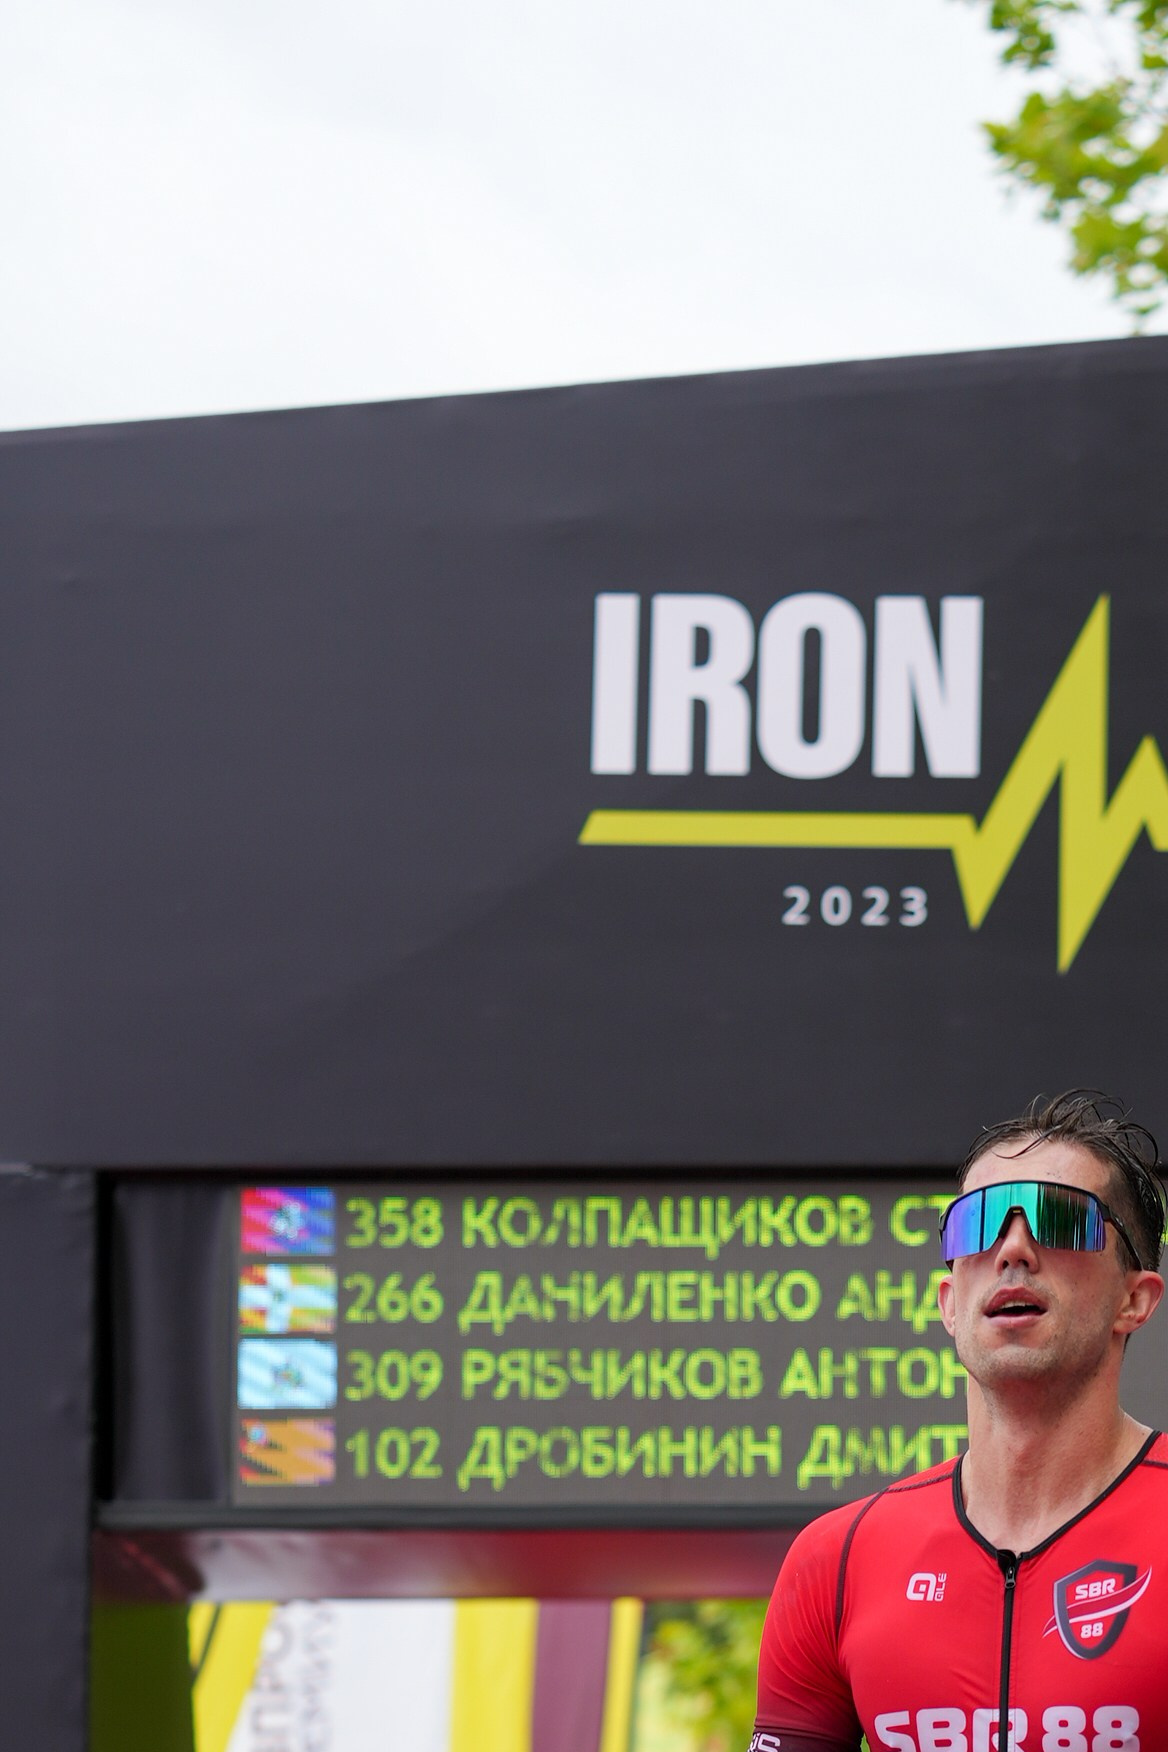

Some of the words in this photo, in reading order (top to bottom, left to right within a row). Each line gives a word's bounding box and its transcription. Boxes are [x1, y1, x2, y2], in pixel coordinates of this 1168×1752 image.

[590, 592, 983, 779] IRON
[782, 885, 929, 927] 2023
[345, 1196, 444, 1248] 358
[462, 1195, 873, 1261] КОЛПАЩИКОВ
[344, 1271, 444, 1323] 266
[345, 1348, 443, 1401] 309
[461, 1348, 763, 1400] РЯБЧИКОВ
[345, 1426, 443, 1479] 102
[457, 1425, 782, 1490] ДРОБИНИН
[1075, 1578, 1116, 1600] SBR
[1080, 1621, 1104, 1639] 88
